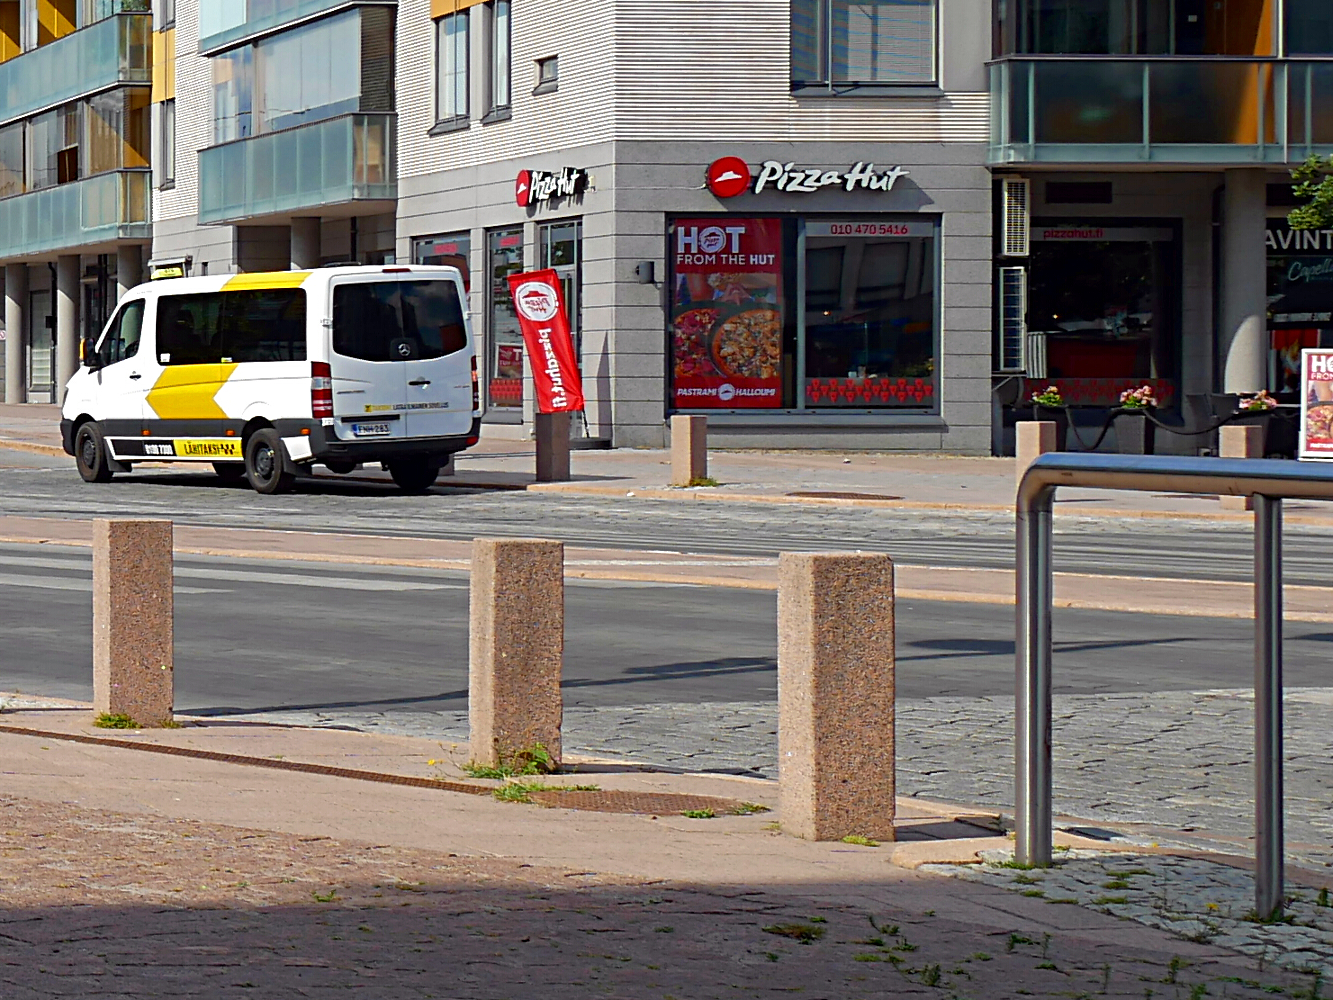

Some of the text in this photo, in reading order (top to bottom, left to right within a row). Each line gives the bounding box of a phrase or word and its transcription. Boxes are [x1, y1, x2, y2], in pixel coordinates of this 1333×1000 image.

[755, 160, 911, 194] Pizza Hut
[528, 167, 580, 204] Pizza Hut
[830, 224, 908, 235] 010 470 5416
[1043, 228, 1104, 240] pizzahut.fi
[677, 226, 746, 254] HOT
[1265, 229, 1333, 250] AVINT
[676, 254, 775, 265] FROM THE HUT
[677, 388, 776, 396] PASTRAMI HALLOUMI
